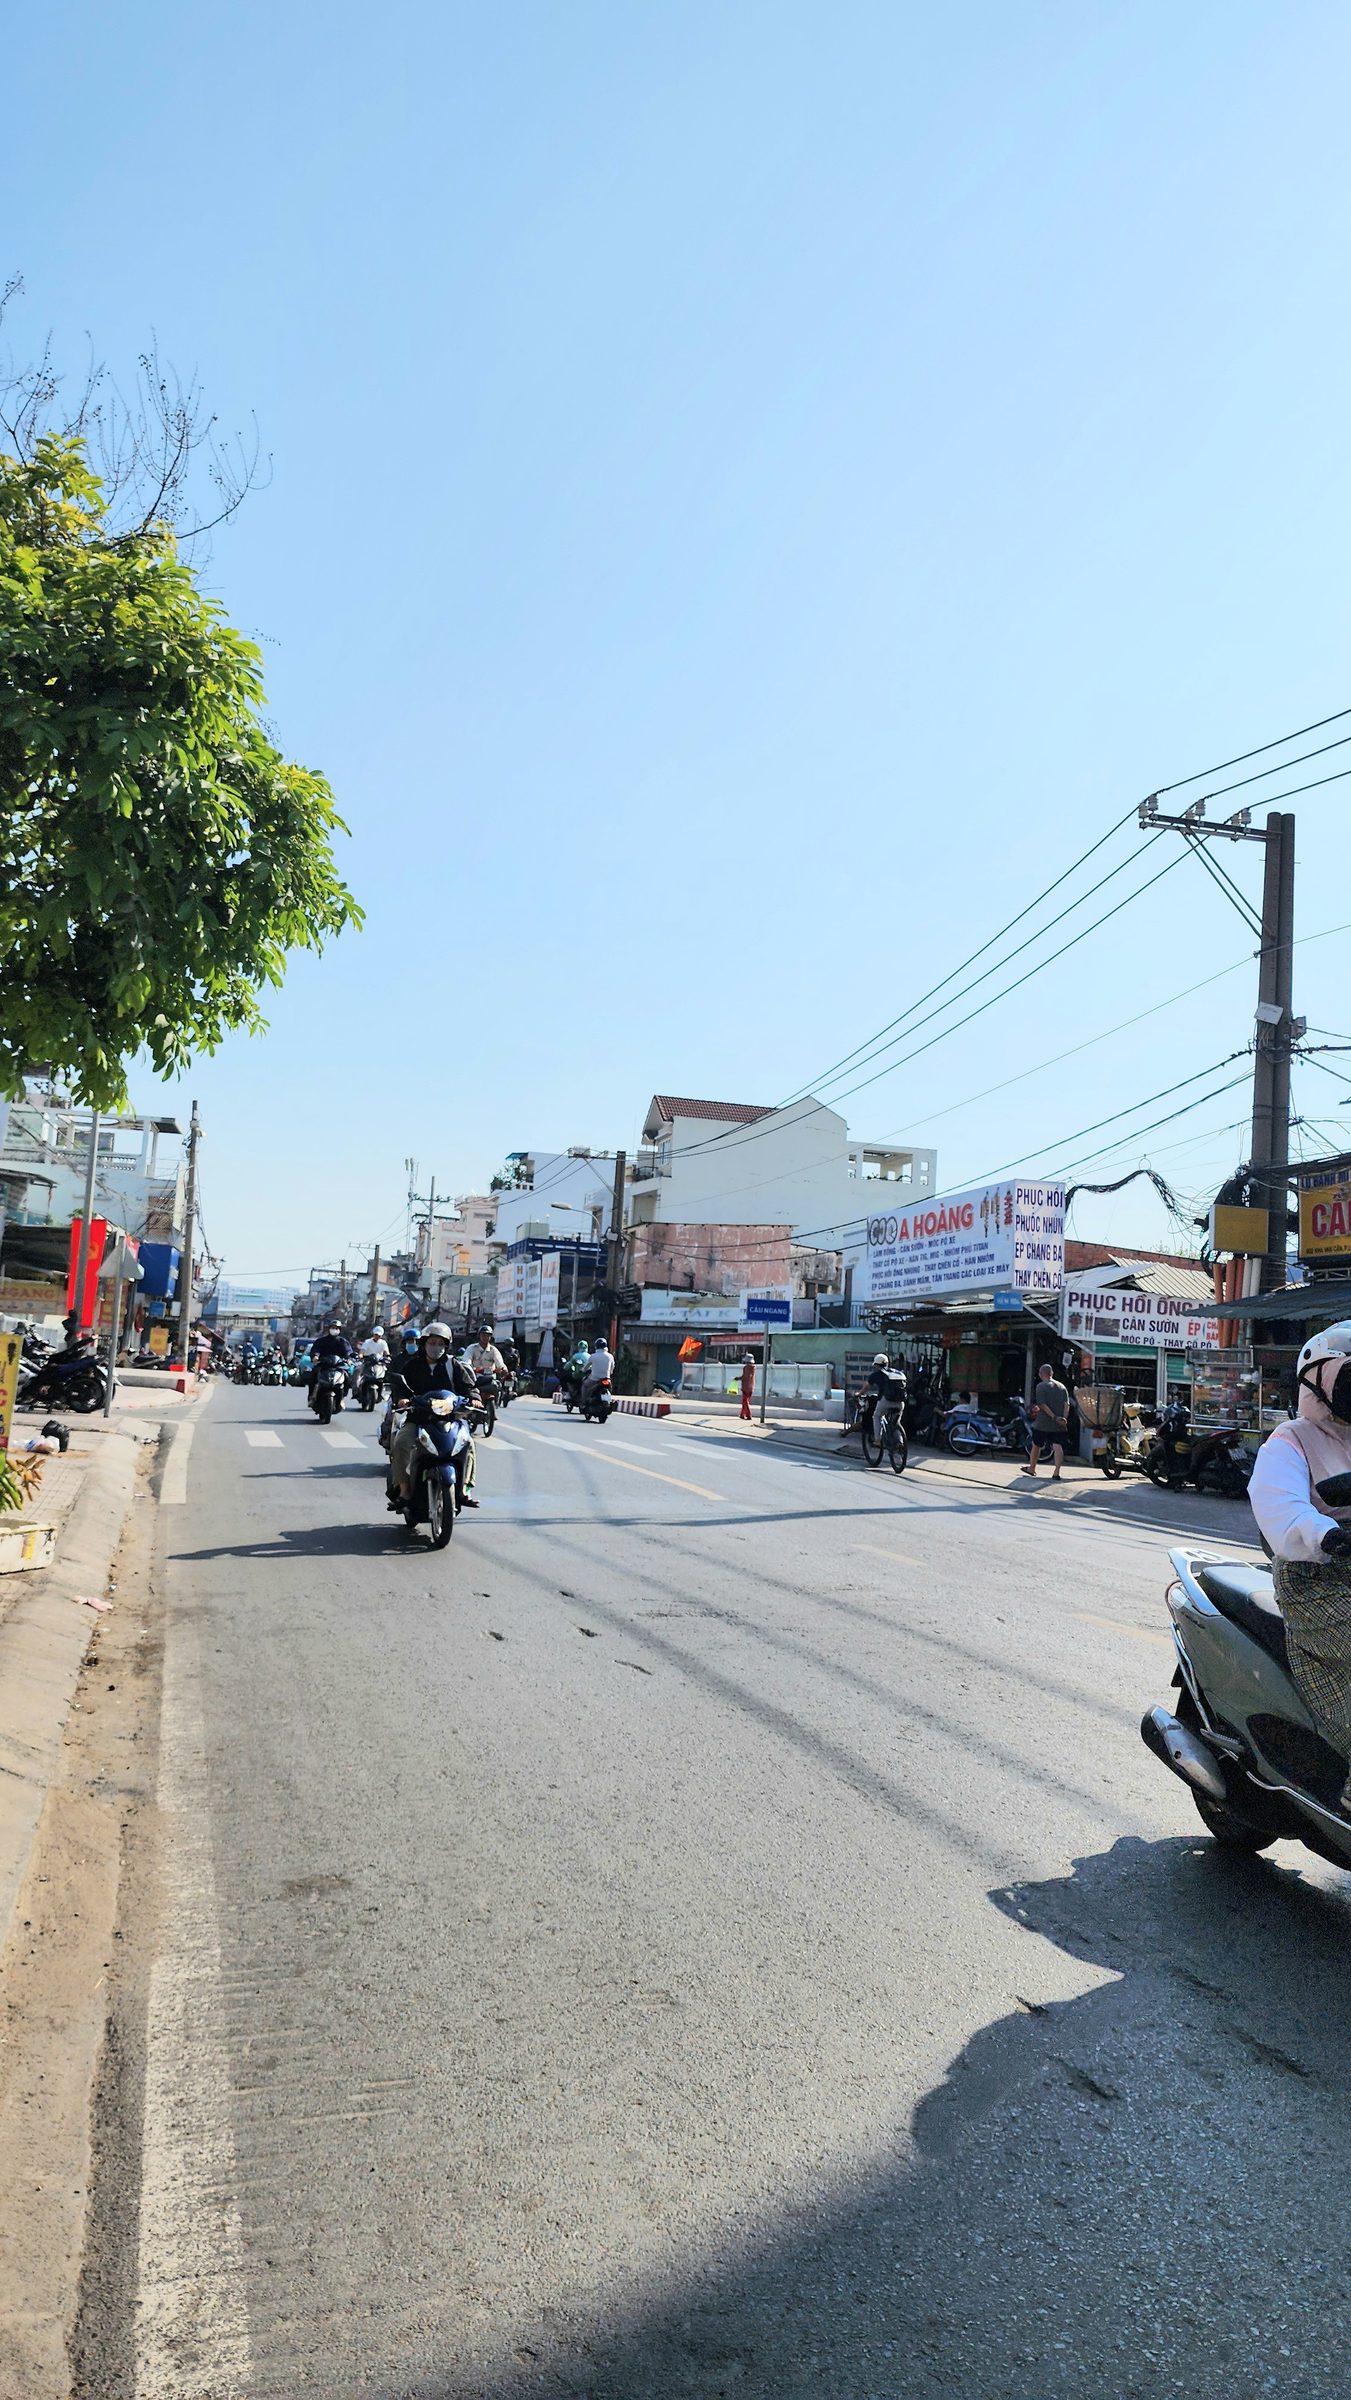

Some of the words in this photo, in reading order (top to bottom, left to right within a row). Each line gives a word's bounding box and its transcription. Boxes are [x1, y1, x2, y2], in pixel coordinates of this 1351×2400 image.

[1016, 1188, 1043, 1209] PHỤC
[1047, 1185, 1063, 1207] HỒI
[900, 1218, 909, 1240] A
[913, 1203, 973, 1239] HOÀNG
[1053, 1245, 1062, 1262] BA
[987, 1264, 995, 1275] XE
[1015, 1269, 1031, 1286] THAY
[764, 1307, 787, 1315] NGANG
[1068, 1292, 1116, 1313] PHỤC
[1122, 1294, 1151, 1314] HỒI
[1149, 1318, 1179, 1334] SƯỜN
[1188, 1319, 1200, 1336] ÉP
[1121, 1335, 1140, 1344] MÓC
[1143, 1336, 1154, 1345] PÔ
[1164, 1338, 1184, 1348] THAY
